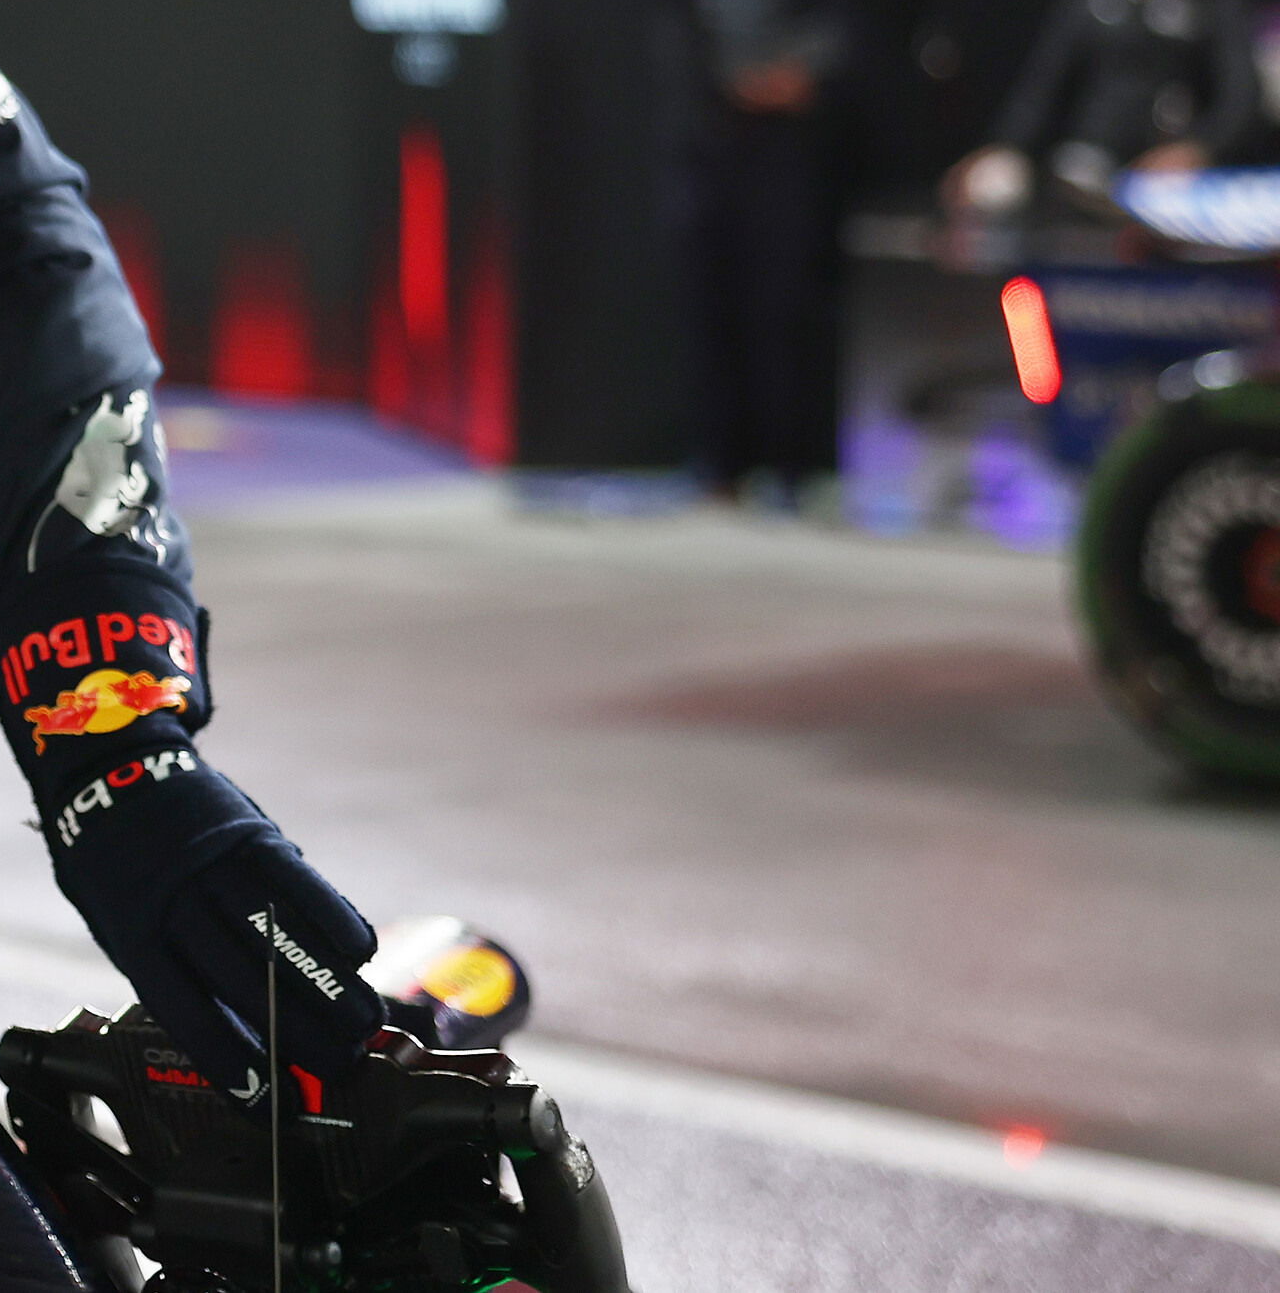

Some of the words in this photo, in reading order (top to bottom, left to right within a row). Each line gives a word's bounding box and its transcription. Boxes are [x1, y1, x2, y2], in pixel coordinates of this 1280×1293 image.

[1, 617, 92, 706] Bull
[95, 610, 196, 675] Red
[56, 750, 197, 848] Mobil
